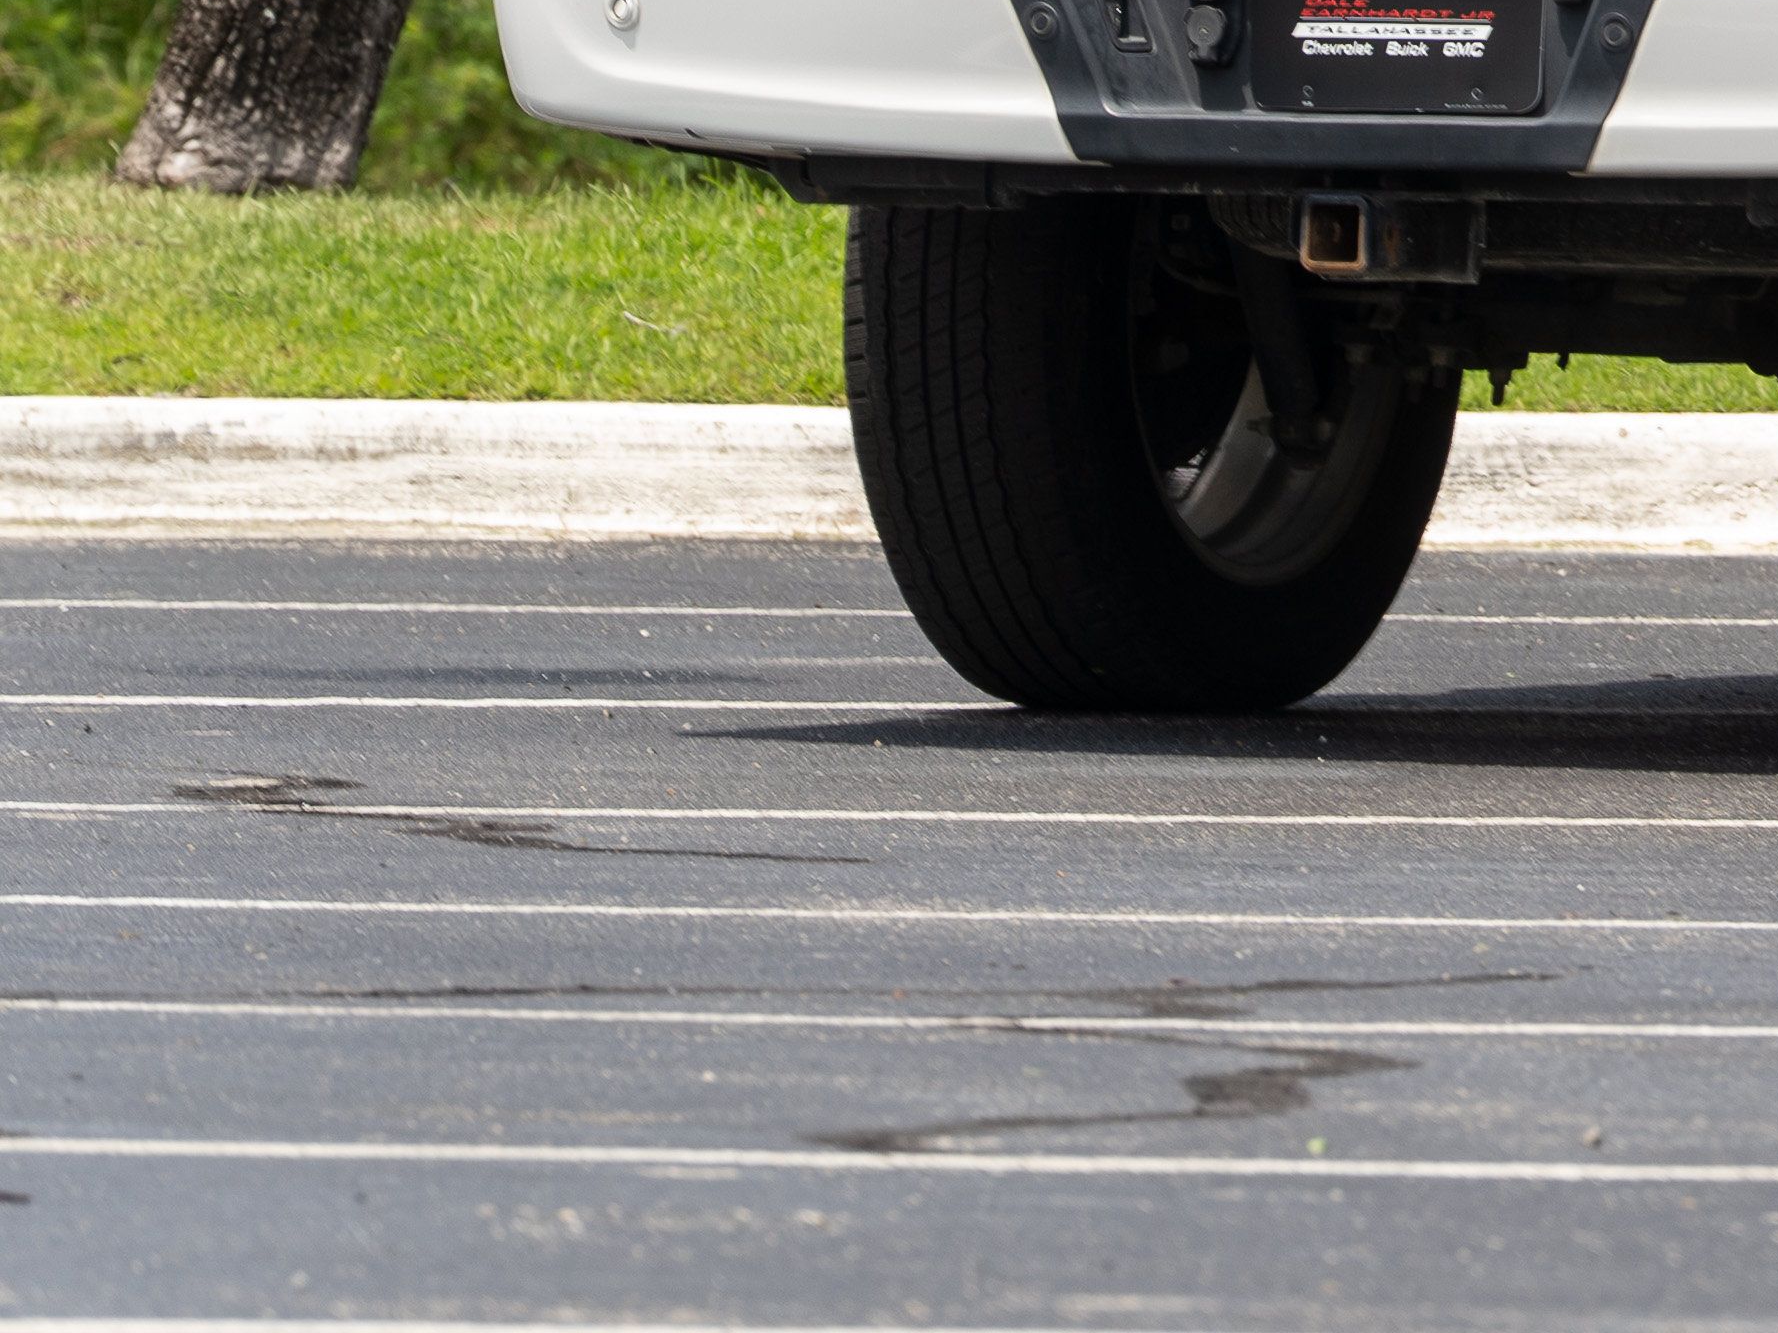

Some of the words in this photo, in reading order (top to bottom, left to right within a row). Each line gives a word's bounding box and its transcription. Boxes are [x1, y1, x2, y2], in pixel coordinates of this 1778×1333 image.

[1301, 7, 1454, 22] EARNHARDT
[1305, 24, 1477, 37] TALLAHASSEE
[1302, 39, 1374, 56] Chevrolet
[1385, 41, 1429, 57] Buick
[1442, 41, 1485, 58] GMC
